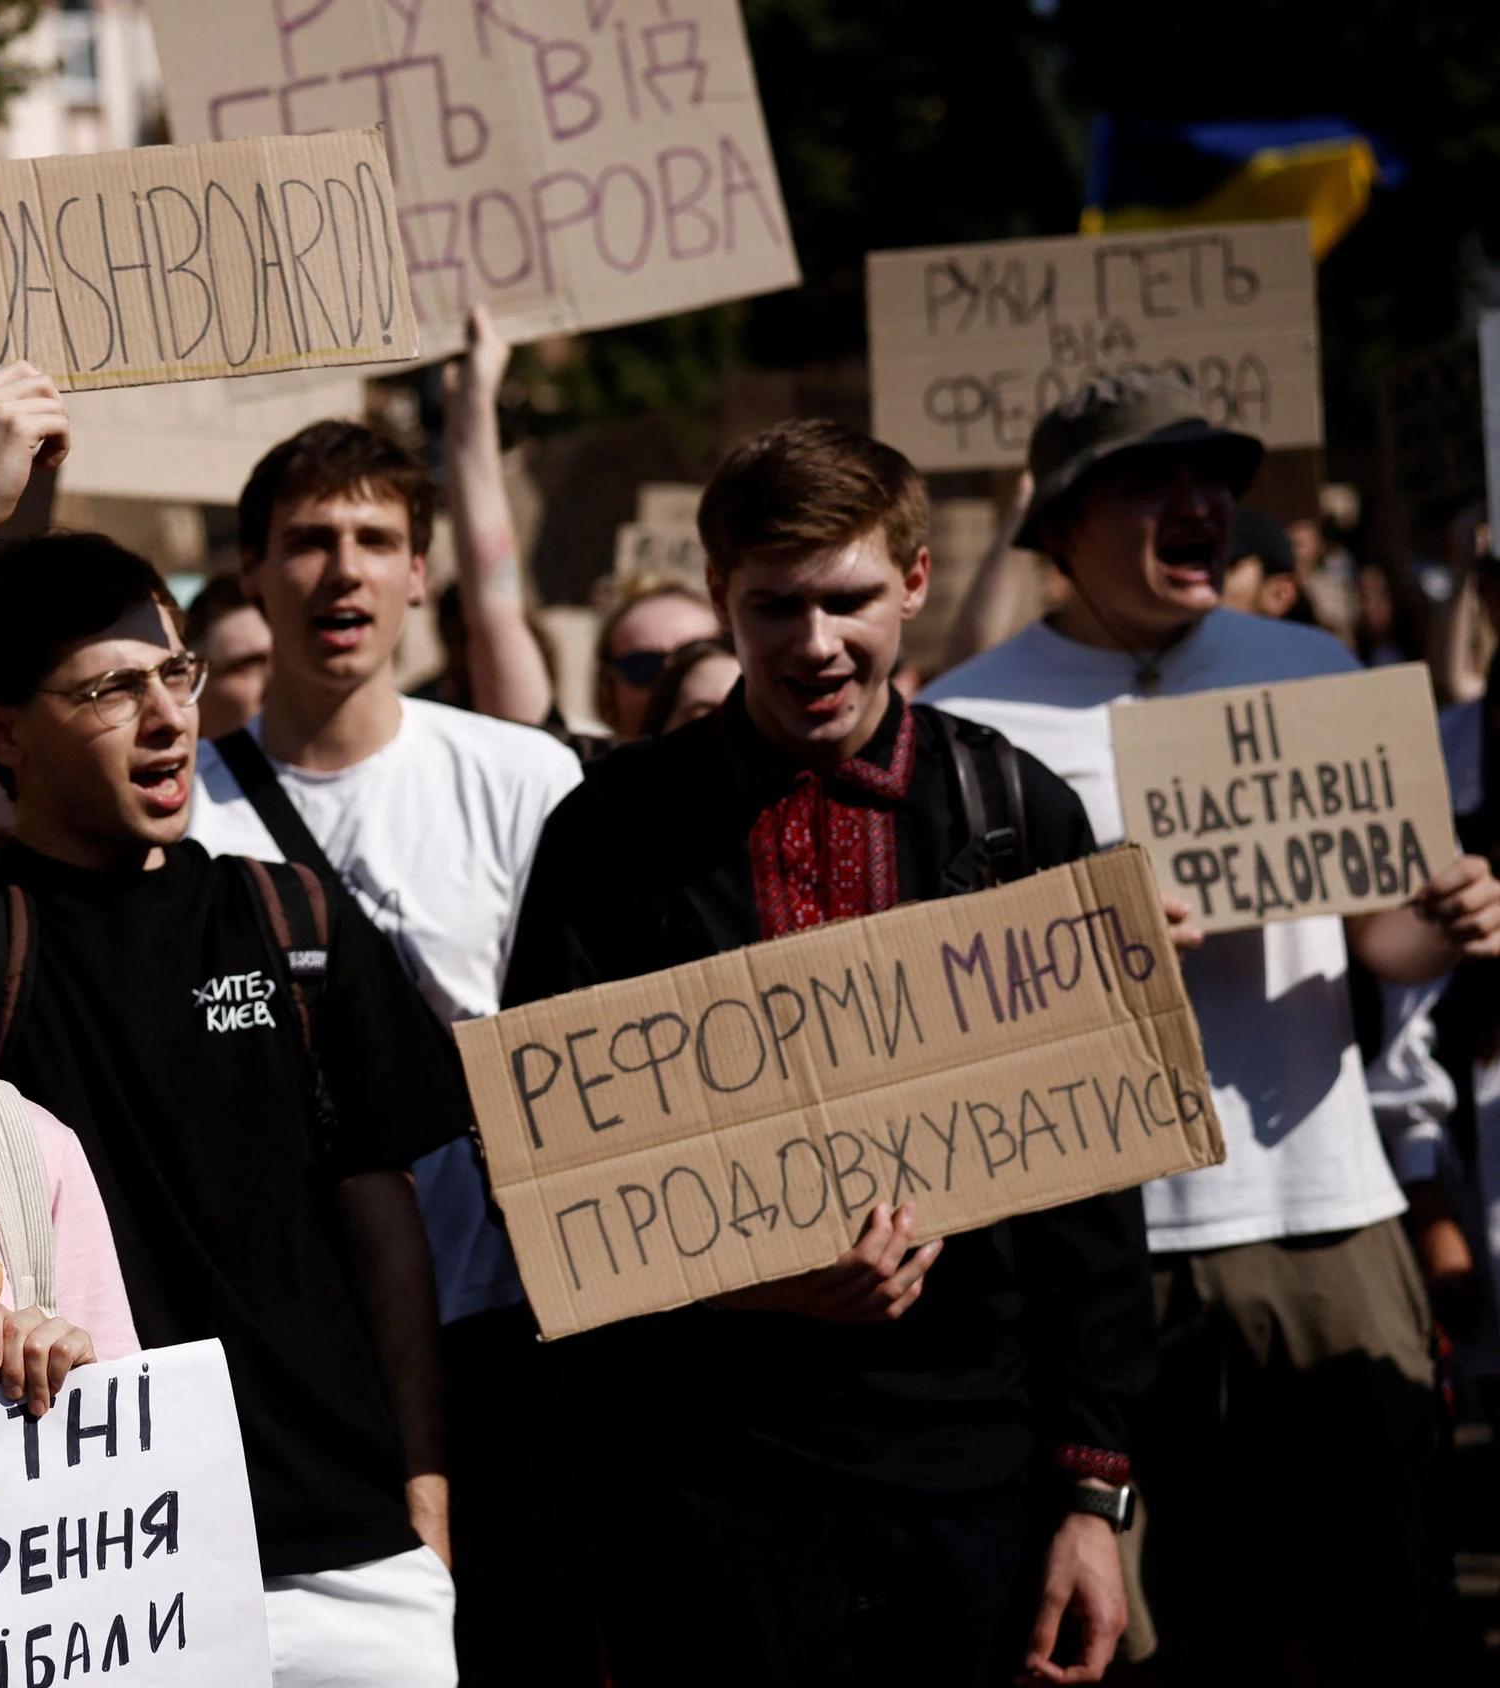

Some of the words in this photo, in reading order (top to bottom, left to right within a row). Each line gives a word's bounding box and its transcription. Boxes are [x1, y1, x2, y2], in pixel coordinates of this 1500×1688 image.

[536, 20, 708, 142] ВІД
[400, 136, 785, 323] ДОРОВА
[923, 256, 1057, 337] РУКИ
[1095, 232, 1260, 319] ГЕТЬ
[922, 352, 1272, 453] ФЕДВА
[1225, 690, 1282, 766] НІ
[1144, 743, 1396, 840] ВІДСТАВЦІ
[1171, 819, 1433, 918] ФЕДОРОВА
[510, 958, 924, 1148] РЕФОРМИ
[941, 905, 1155, 1034] МАЮТЬ
[556, 1066, 1203, 1290] ПРОДОВЖУВАТИСЬ
